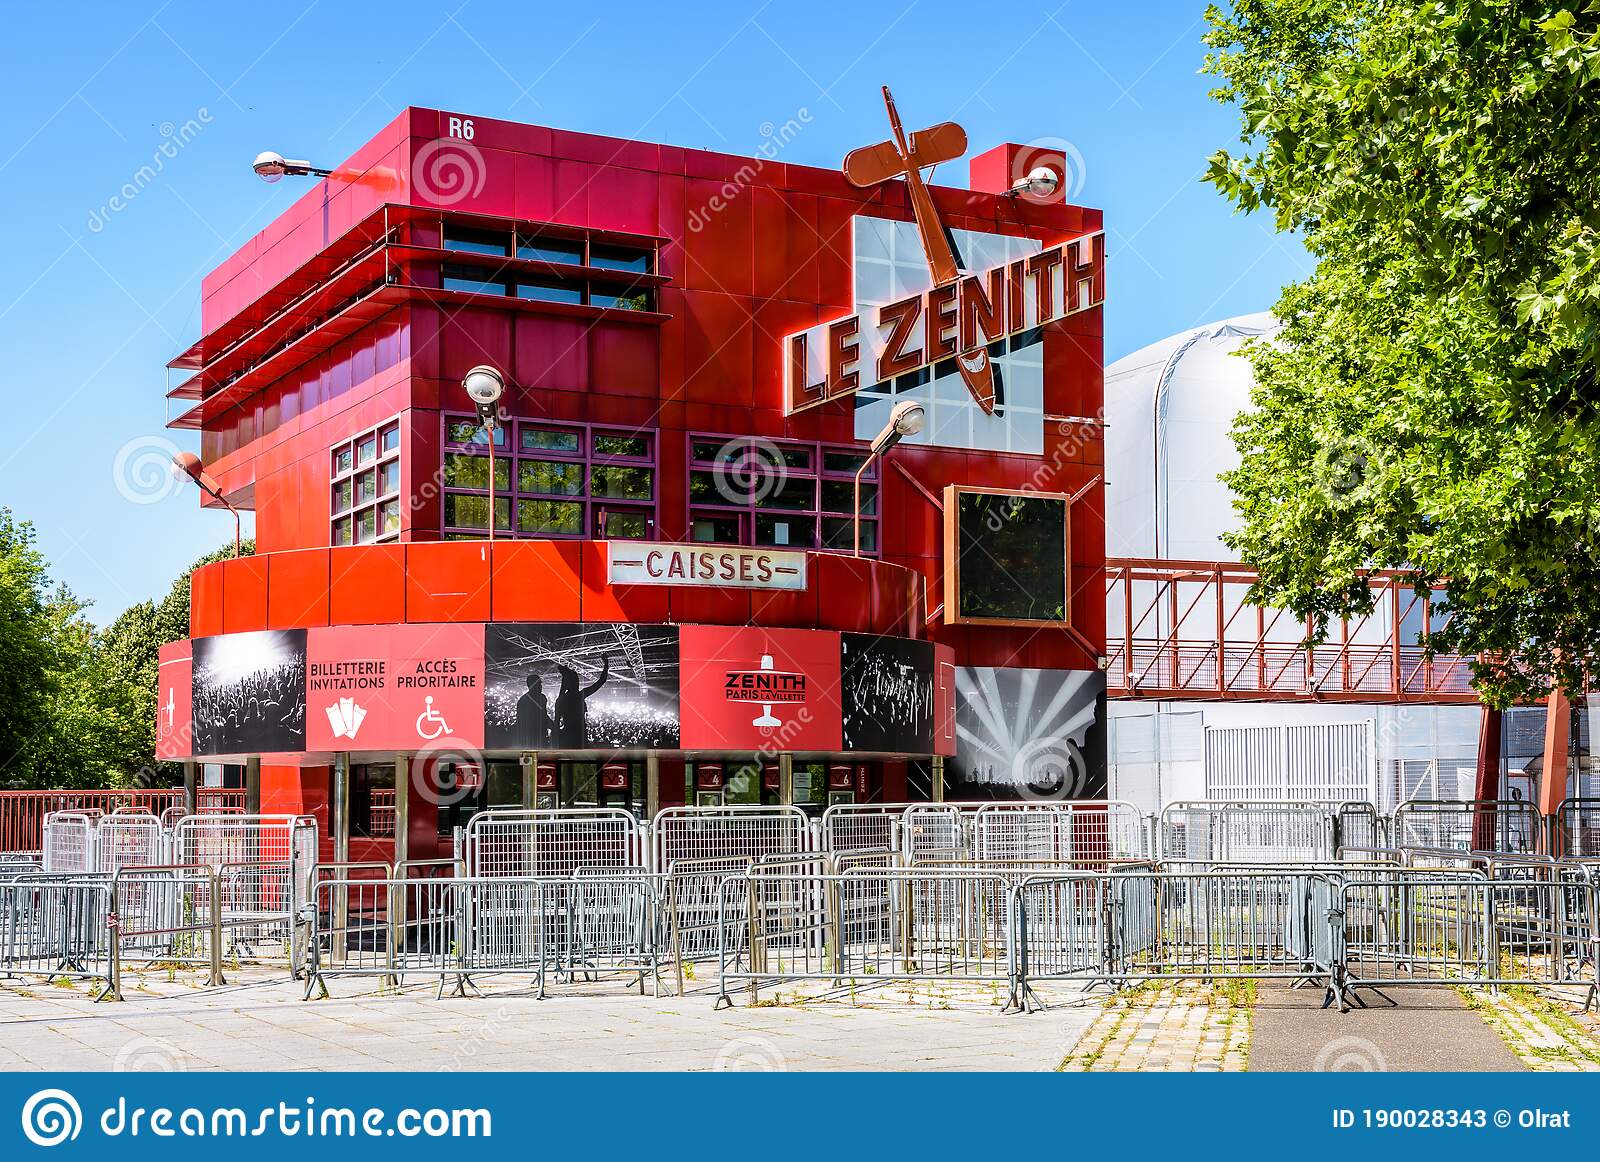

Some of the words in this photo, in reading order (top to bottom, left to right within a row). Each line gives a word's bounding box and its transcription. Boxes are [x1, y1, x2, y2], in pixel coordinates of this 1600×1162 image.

[449, 117, 475, 140] R6
[790, 314, 860, 410] LE
[877, 233, 1105, 382] ZENITH
[646, 550, 772, 582] CAISSES
[310, 662, 385, 676] BILLETTERIE
[415, 658, 457, 673] ACCÈS
[310, 677, 385, 690] INVITATIONS
[397, 675, 476, 688] PRIORITAIRE
[725, 673, 806, 690] ZENITH
[726, 689, 759, 699] PARIS
[771, 690, 806, 701] VILLETTE
[472, 774, 478, 785] 1
[546, 774, 553, 785] 2
[618, 774, 625, 785] 3
[712, 774, 720, 785] 4
[843, 774, 849, 785] 6
